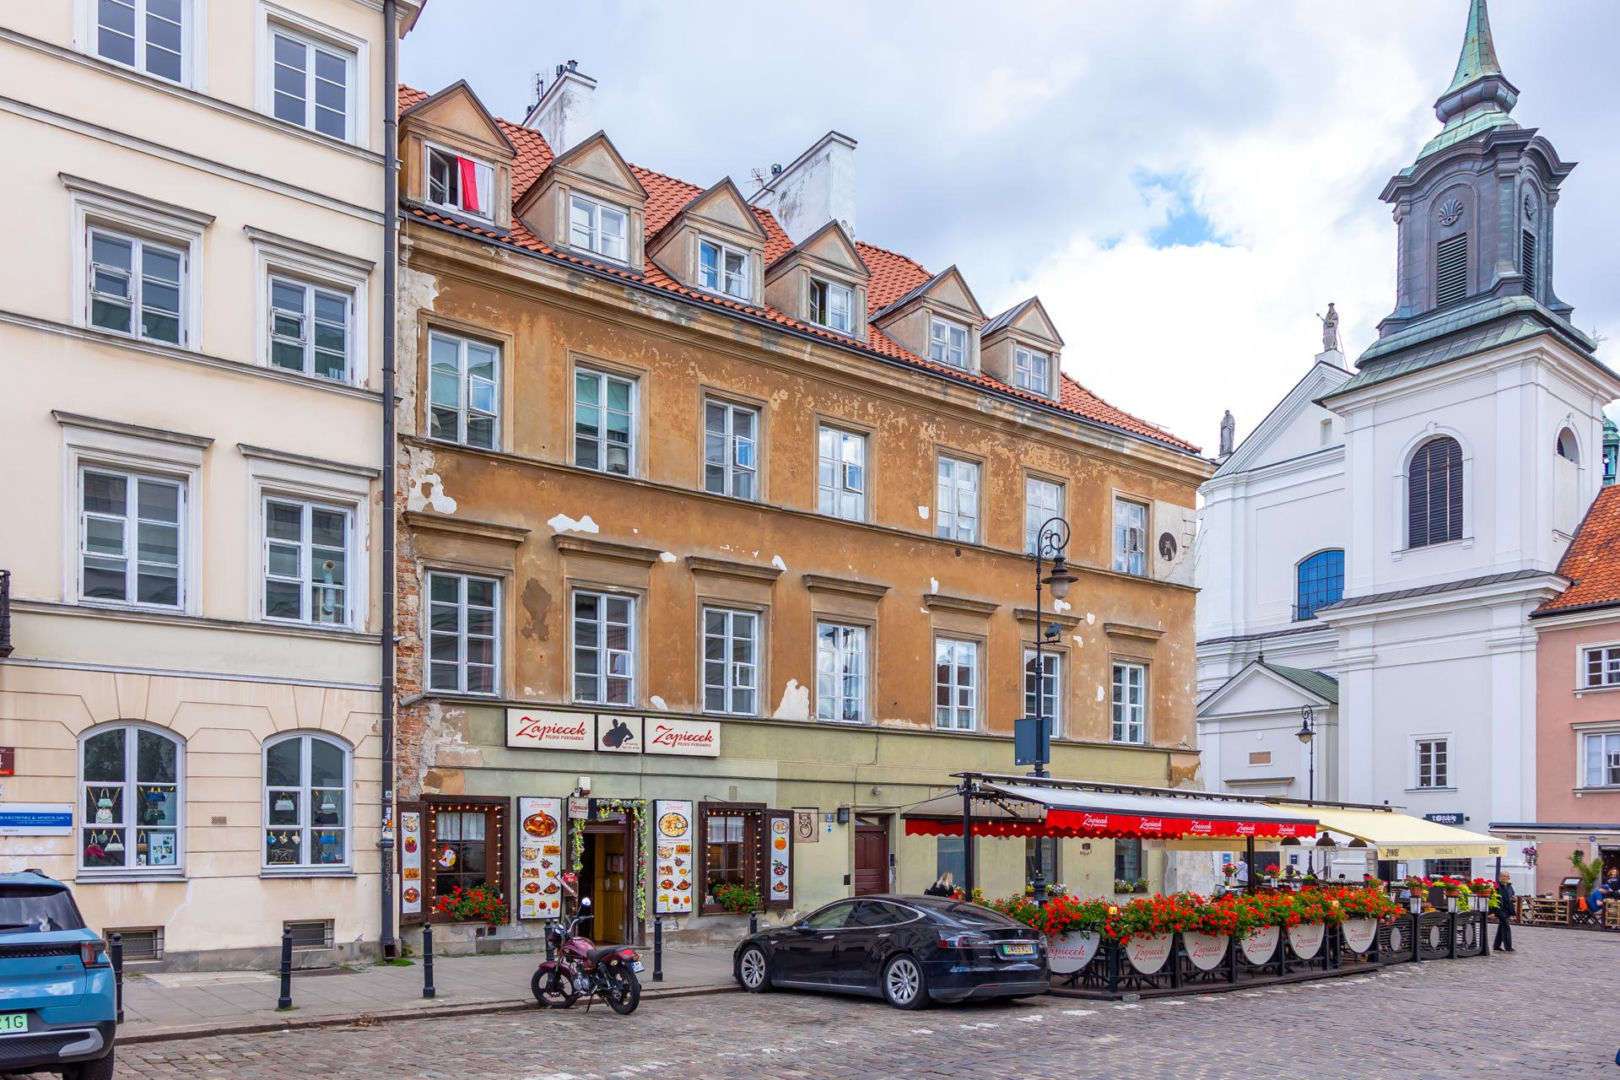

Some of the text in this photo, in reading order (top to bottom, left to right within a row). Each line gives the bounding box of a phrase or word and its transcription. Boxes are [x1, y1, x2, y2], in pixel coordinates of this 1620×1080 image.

[515, 716, 587, 741] Zapiecek
[652, 724, 714, 747] Zapiecek
[0, 1015, 23, 1029] 1G
